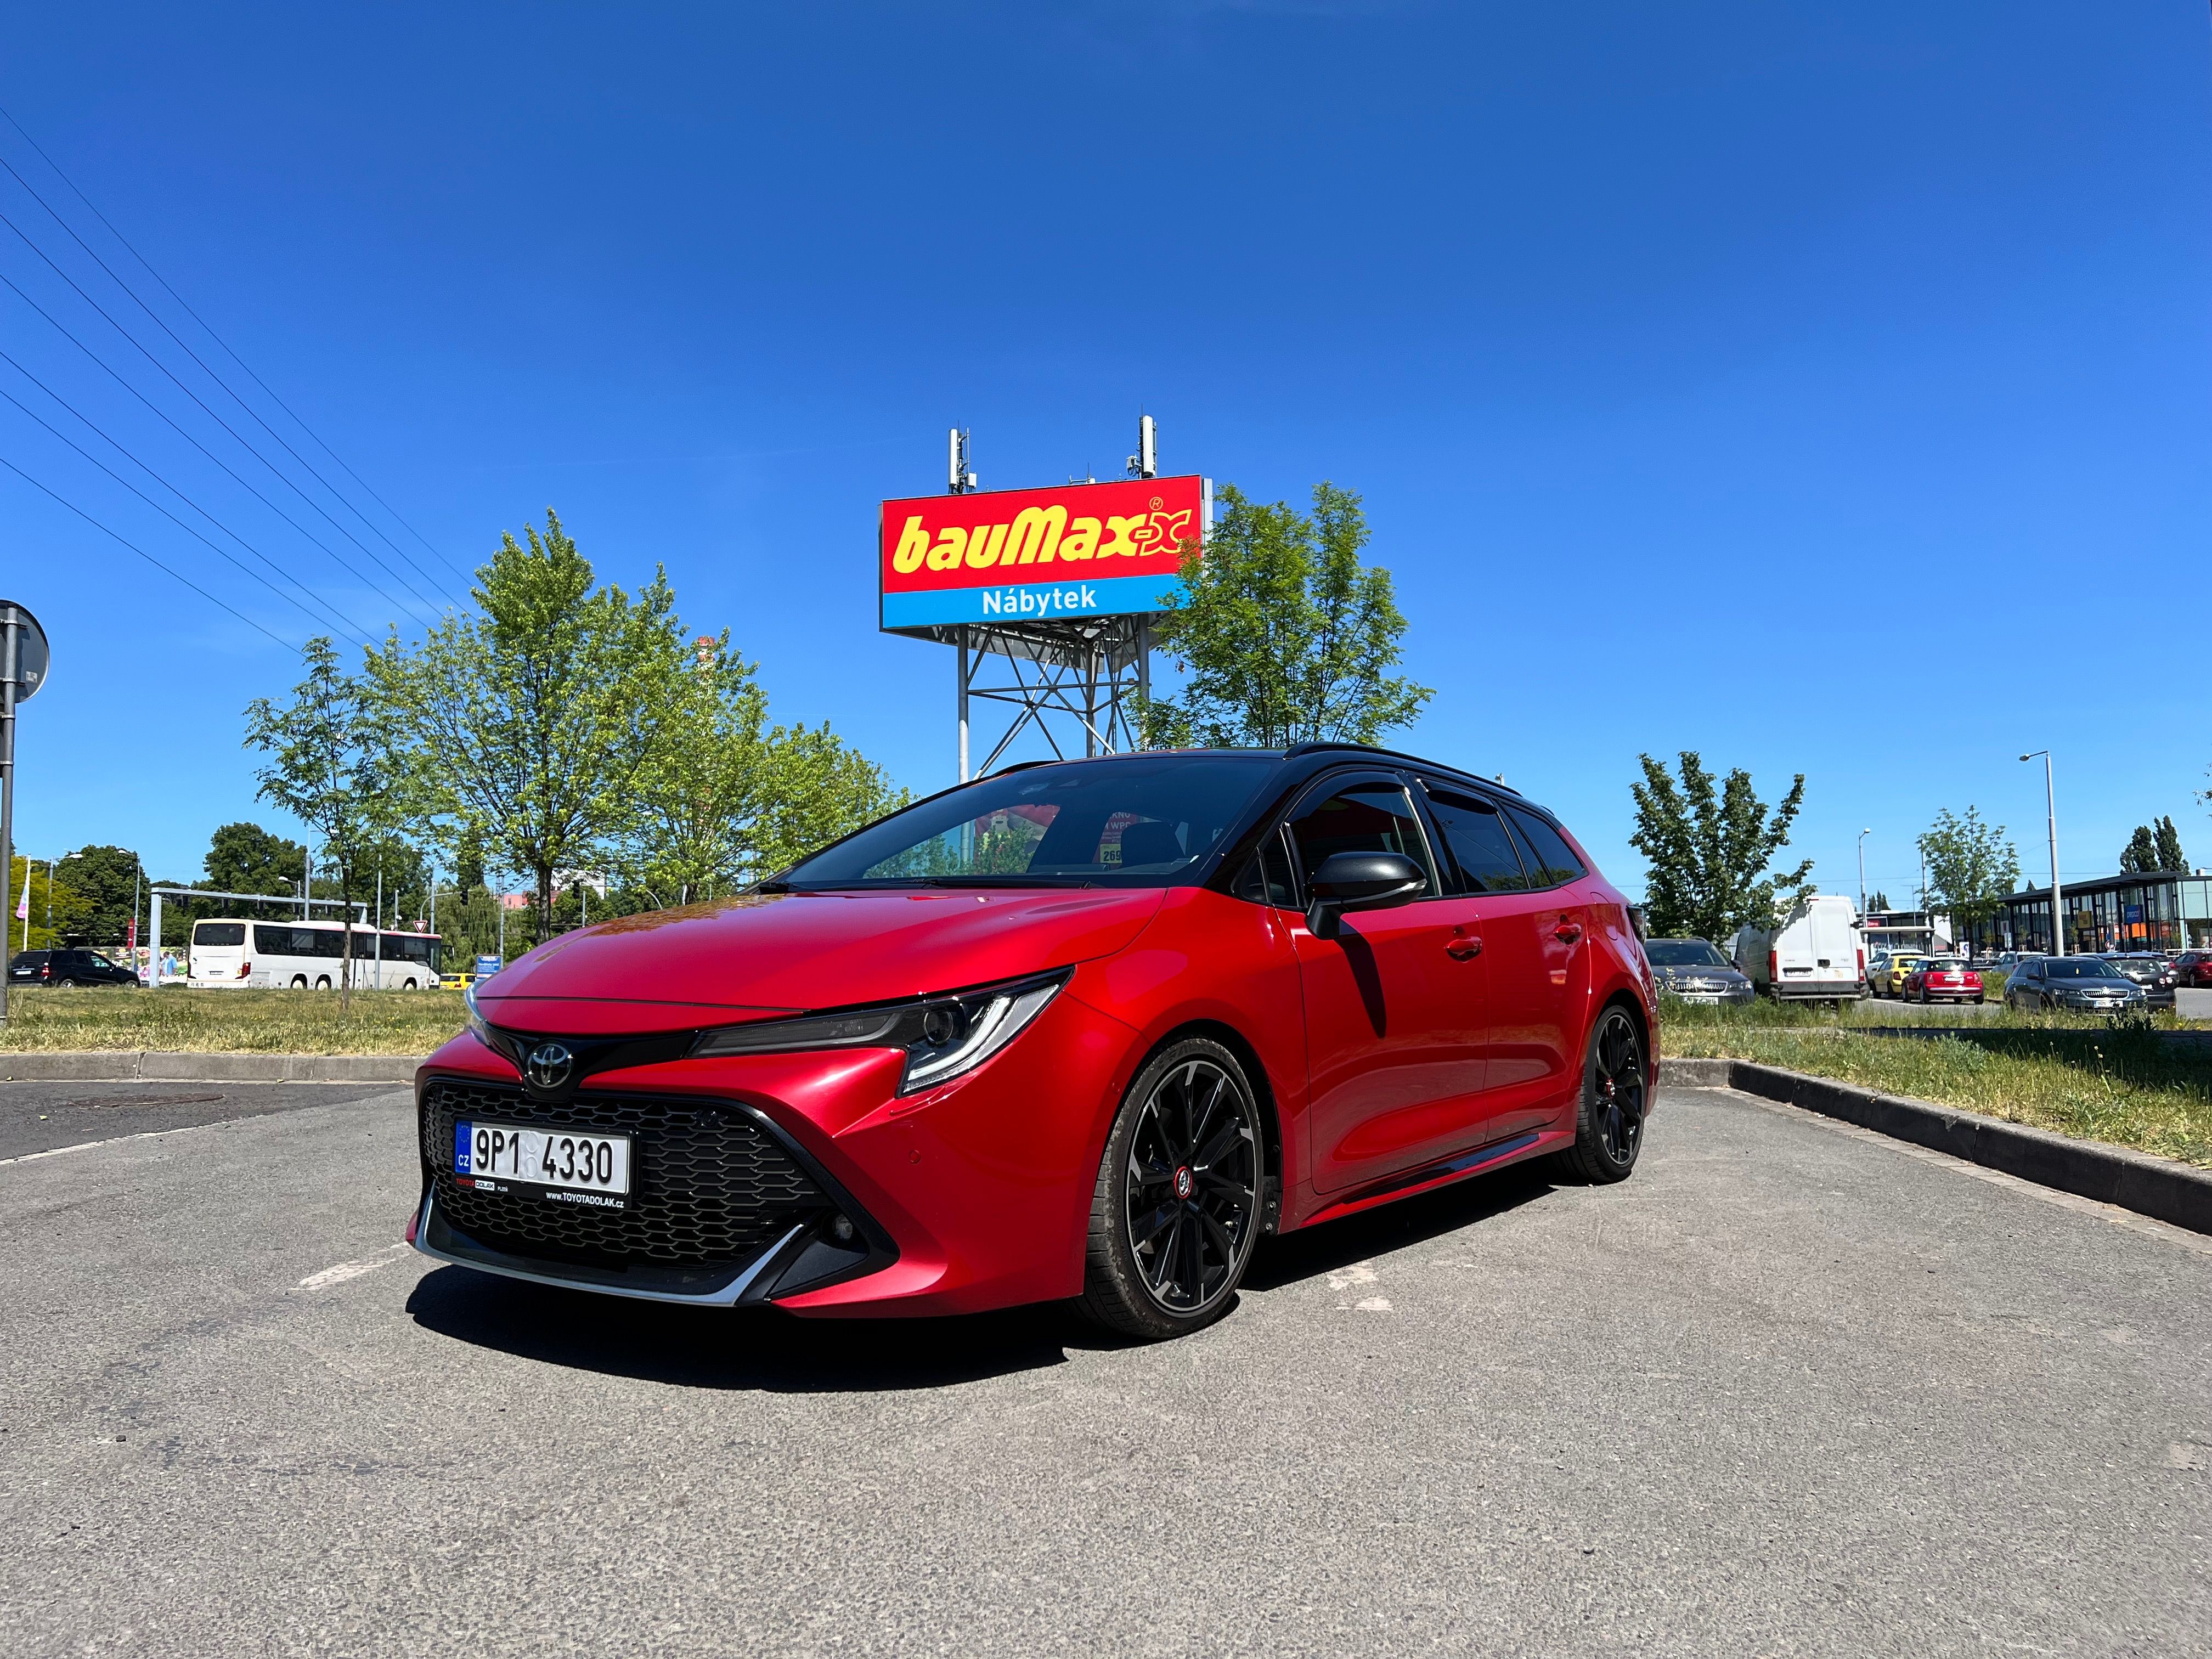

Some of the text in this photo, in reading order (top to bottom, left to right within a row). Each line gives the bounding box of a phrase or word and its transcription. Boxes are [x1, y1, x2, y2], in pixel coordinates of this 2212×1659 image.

[983, 584, 1097, 617] Nábytek
[458, 1154, 469, 1167] CZ
[476, 1129, 613, 1184] 9P1 4330
[456, 1178, 475, 1187] TOYOTA
[545, 1192, 624, 1208] www.TOYOTADOLAK.cz
